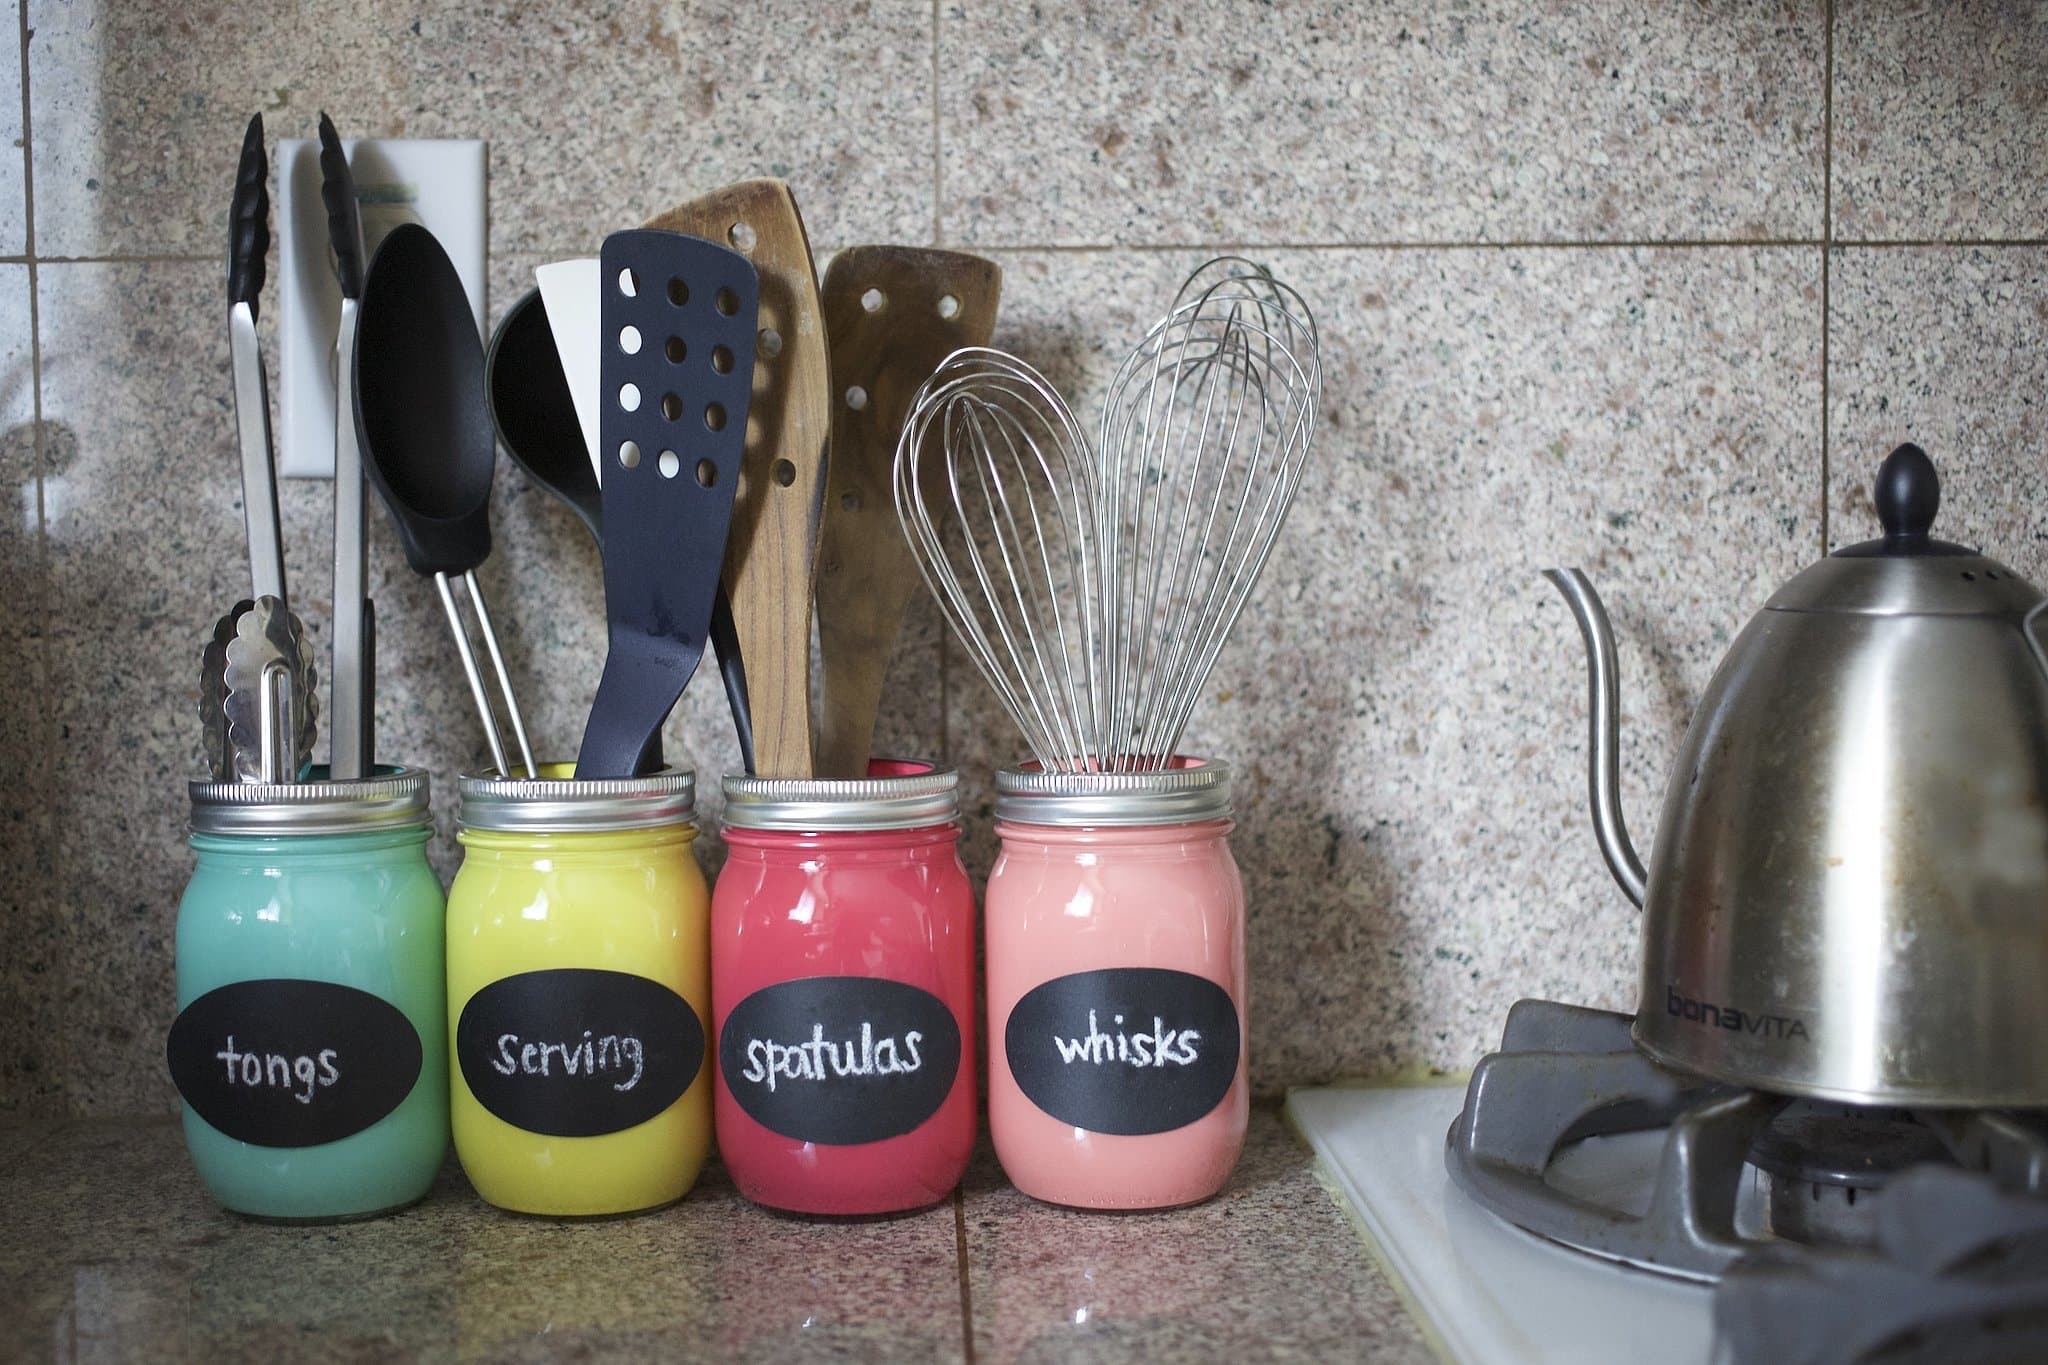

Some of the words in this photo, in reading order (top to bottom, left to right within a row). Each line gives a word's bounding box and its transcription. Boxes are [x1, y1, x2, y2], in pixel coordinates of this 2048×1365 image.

[216, 1035, 340, 1103] tongs
[742, 1022, 923, 1092] spatulas
[1054, 1009, 1202, 1068] whisks
